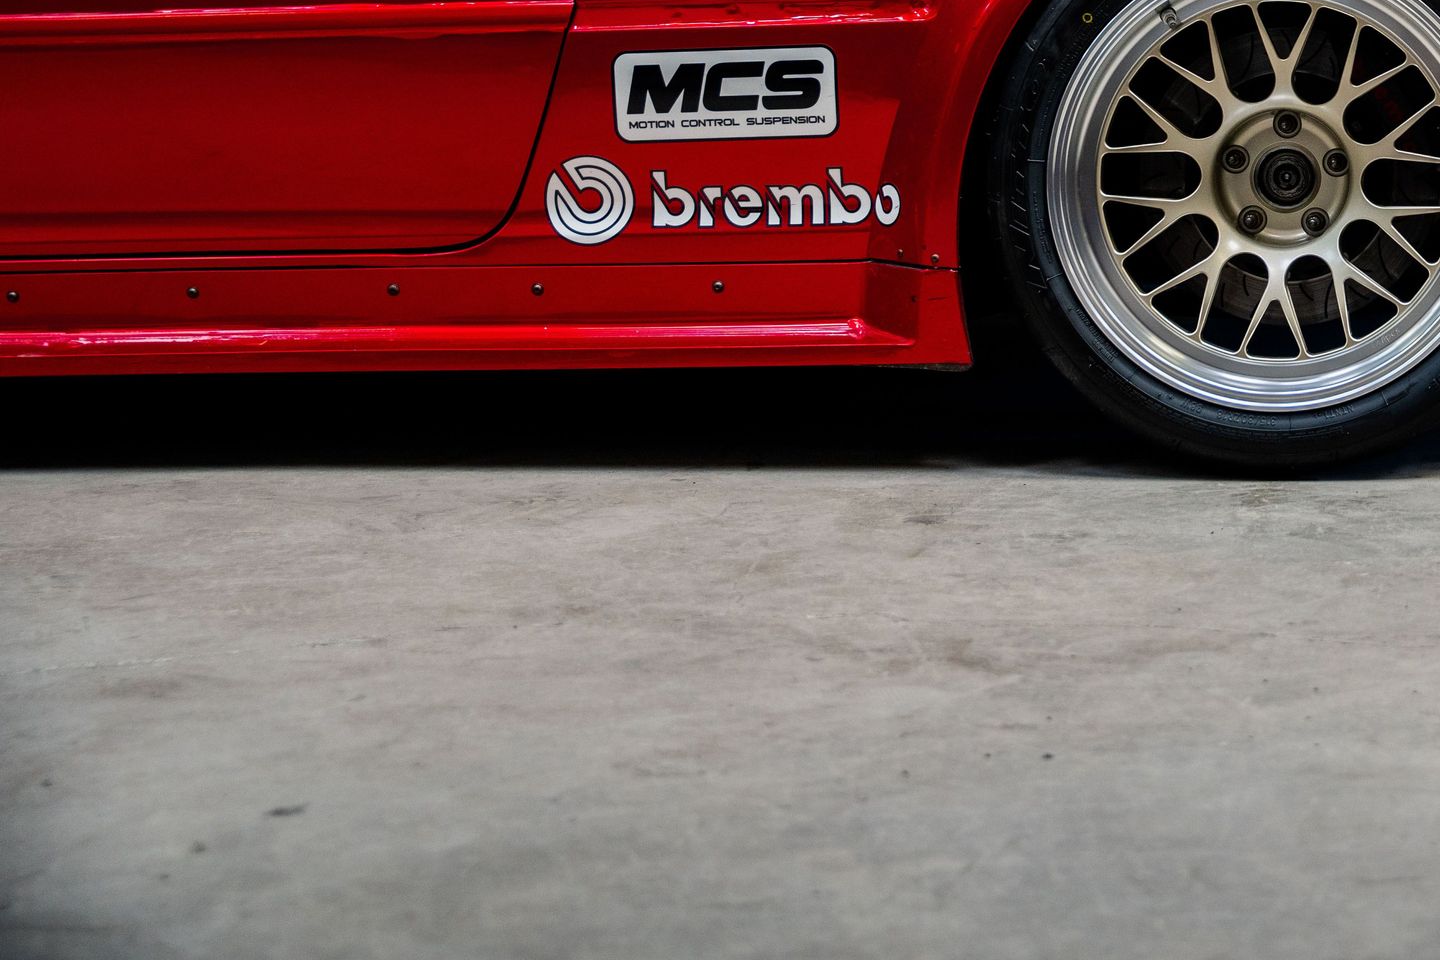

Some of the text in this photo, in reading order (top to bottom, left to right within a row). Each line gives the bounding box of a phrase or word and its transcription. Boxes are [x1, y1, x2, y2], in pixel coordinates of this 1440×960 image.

[626, 59, 825, 115] MCS
[628, 114, 827, 130] MOTION CONTROL SUSPENSION
[650, 166, 902, 229] brembo
